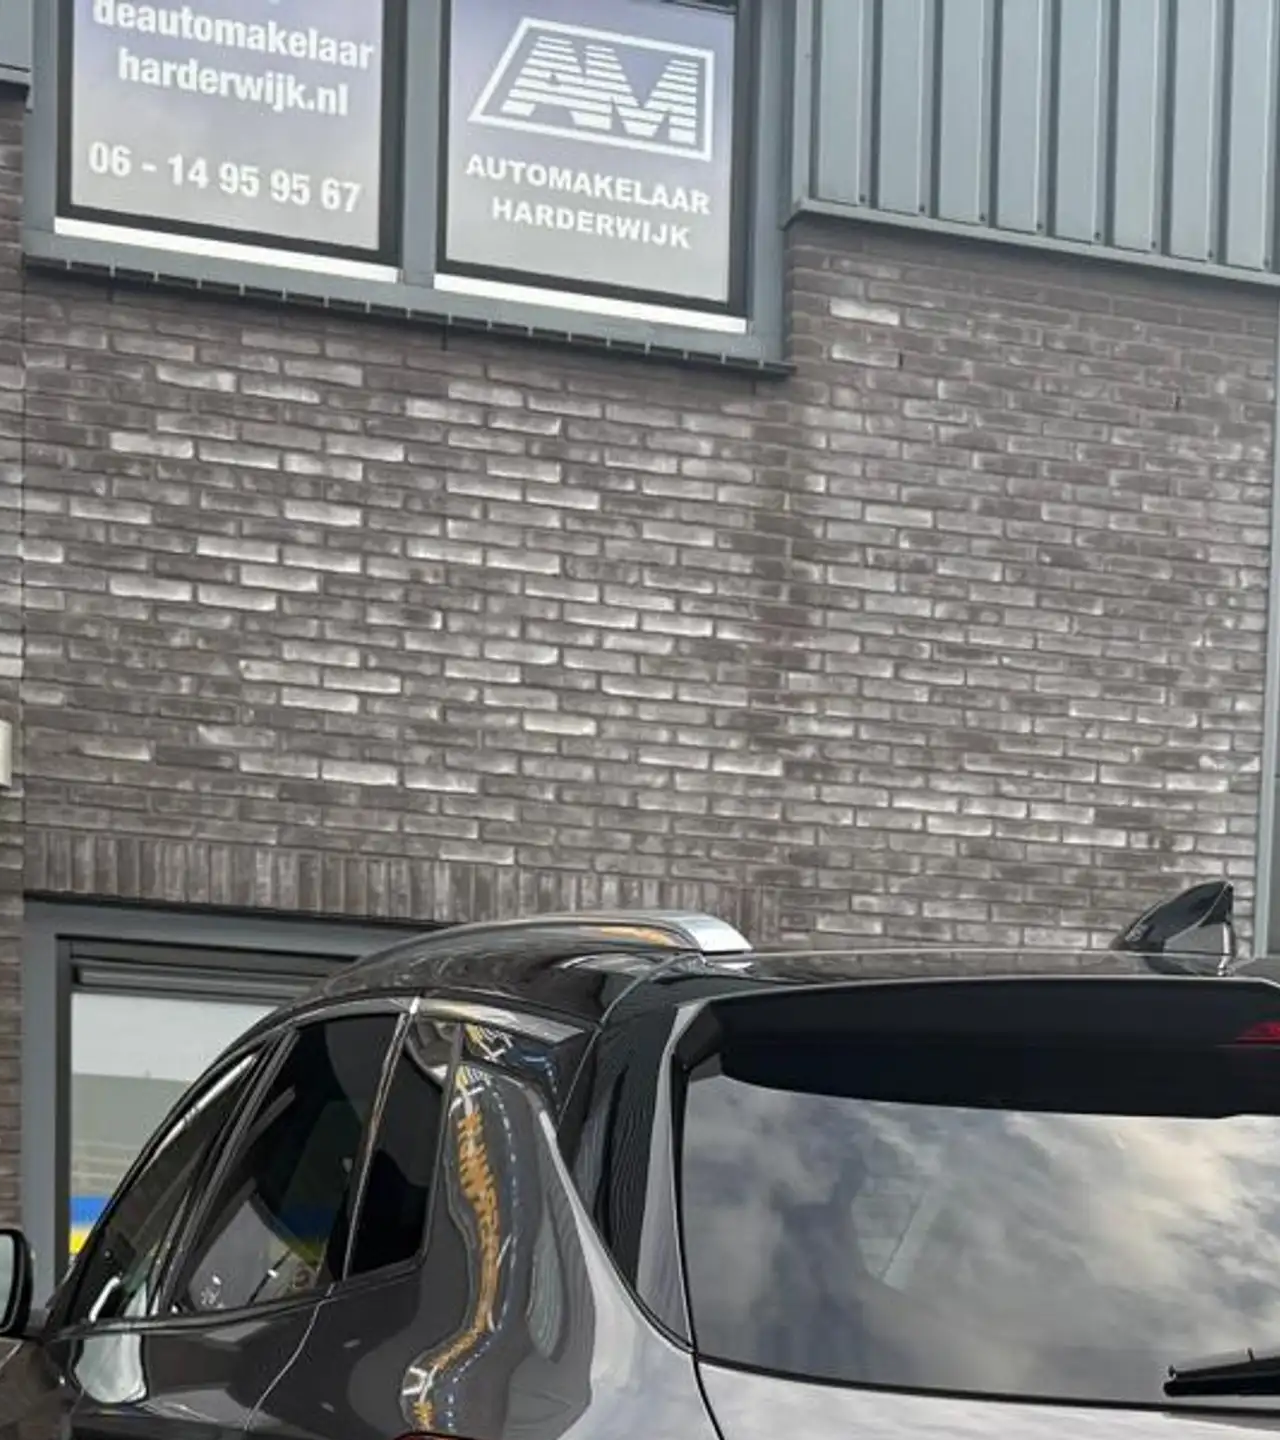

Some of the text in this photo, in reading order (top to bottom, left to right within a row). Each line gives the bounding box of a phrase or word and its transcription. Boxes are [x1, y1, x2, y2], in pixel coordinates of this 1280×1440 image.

[92, 0, 377, 69] deautomakelaar
[119, 46, 350, 116] harderwijk.nl
[498, 33, 700, 145] AM
[88, 141, 132, 178] 06
[168, 153, 210, 190] 14
[219, 164, 260, 200] 95
[270, 171, 312, 206] 95
[321, 177, 362, 213] 67
[465, 152, 712, 216] AUTOMAKELAAR
[491, 196, 693, 250] HARDERWIJK
